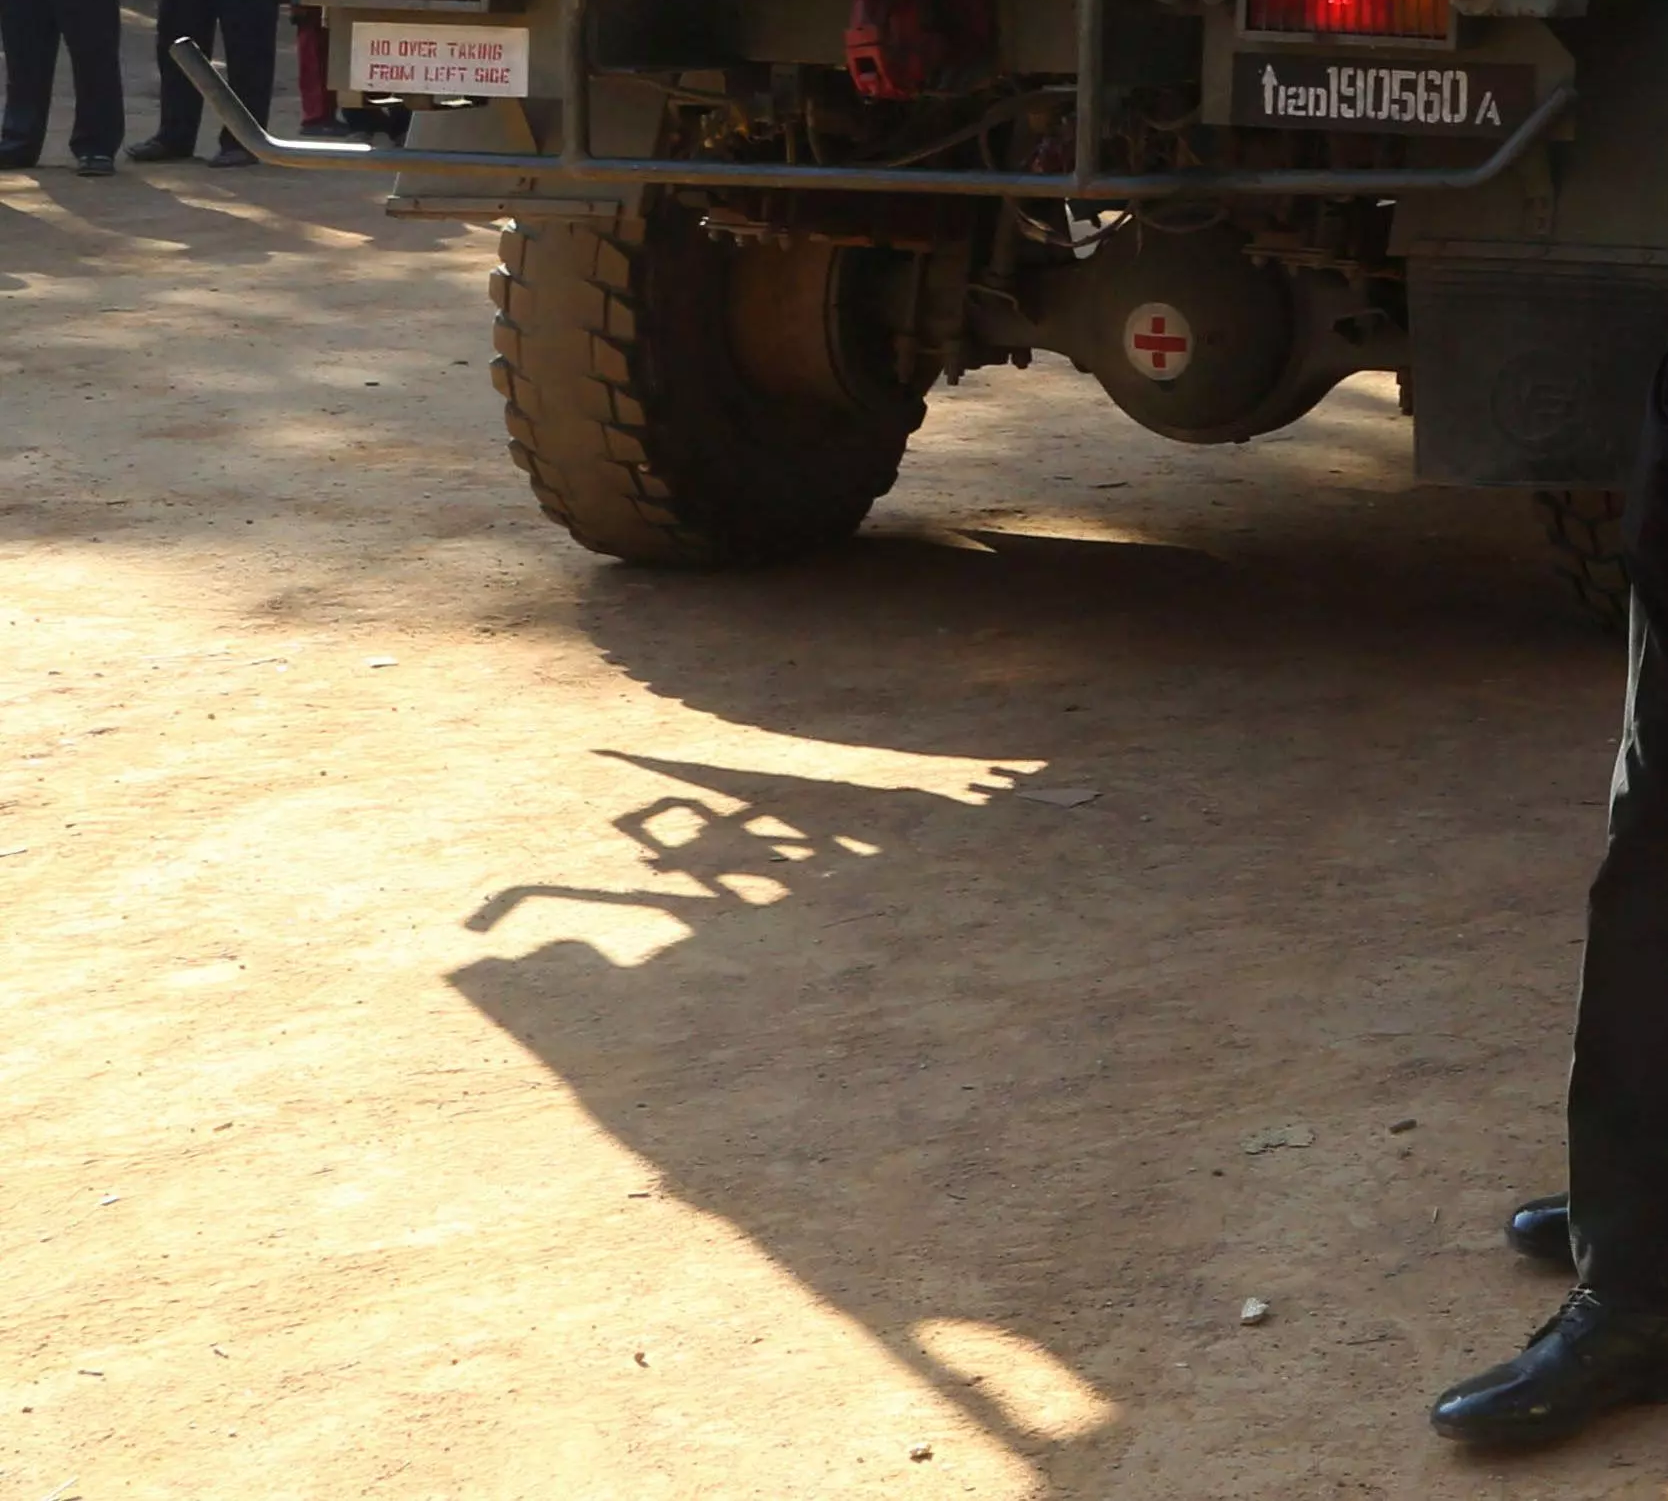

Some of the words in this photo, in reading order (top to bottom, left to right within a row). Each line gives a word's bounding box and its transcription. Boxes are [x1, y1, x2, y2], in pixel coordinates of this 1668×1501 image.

[370, 40, 391, 56] NO
[399, 40, 438, 58] OVER
[447, 42, 502, 61] TAKING
[369, 64, 415, 81] FROM
[424, 66, 467, 82] LEFT
